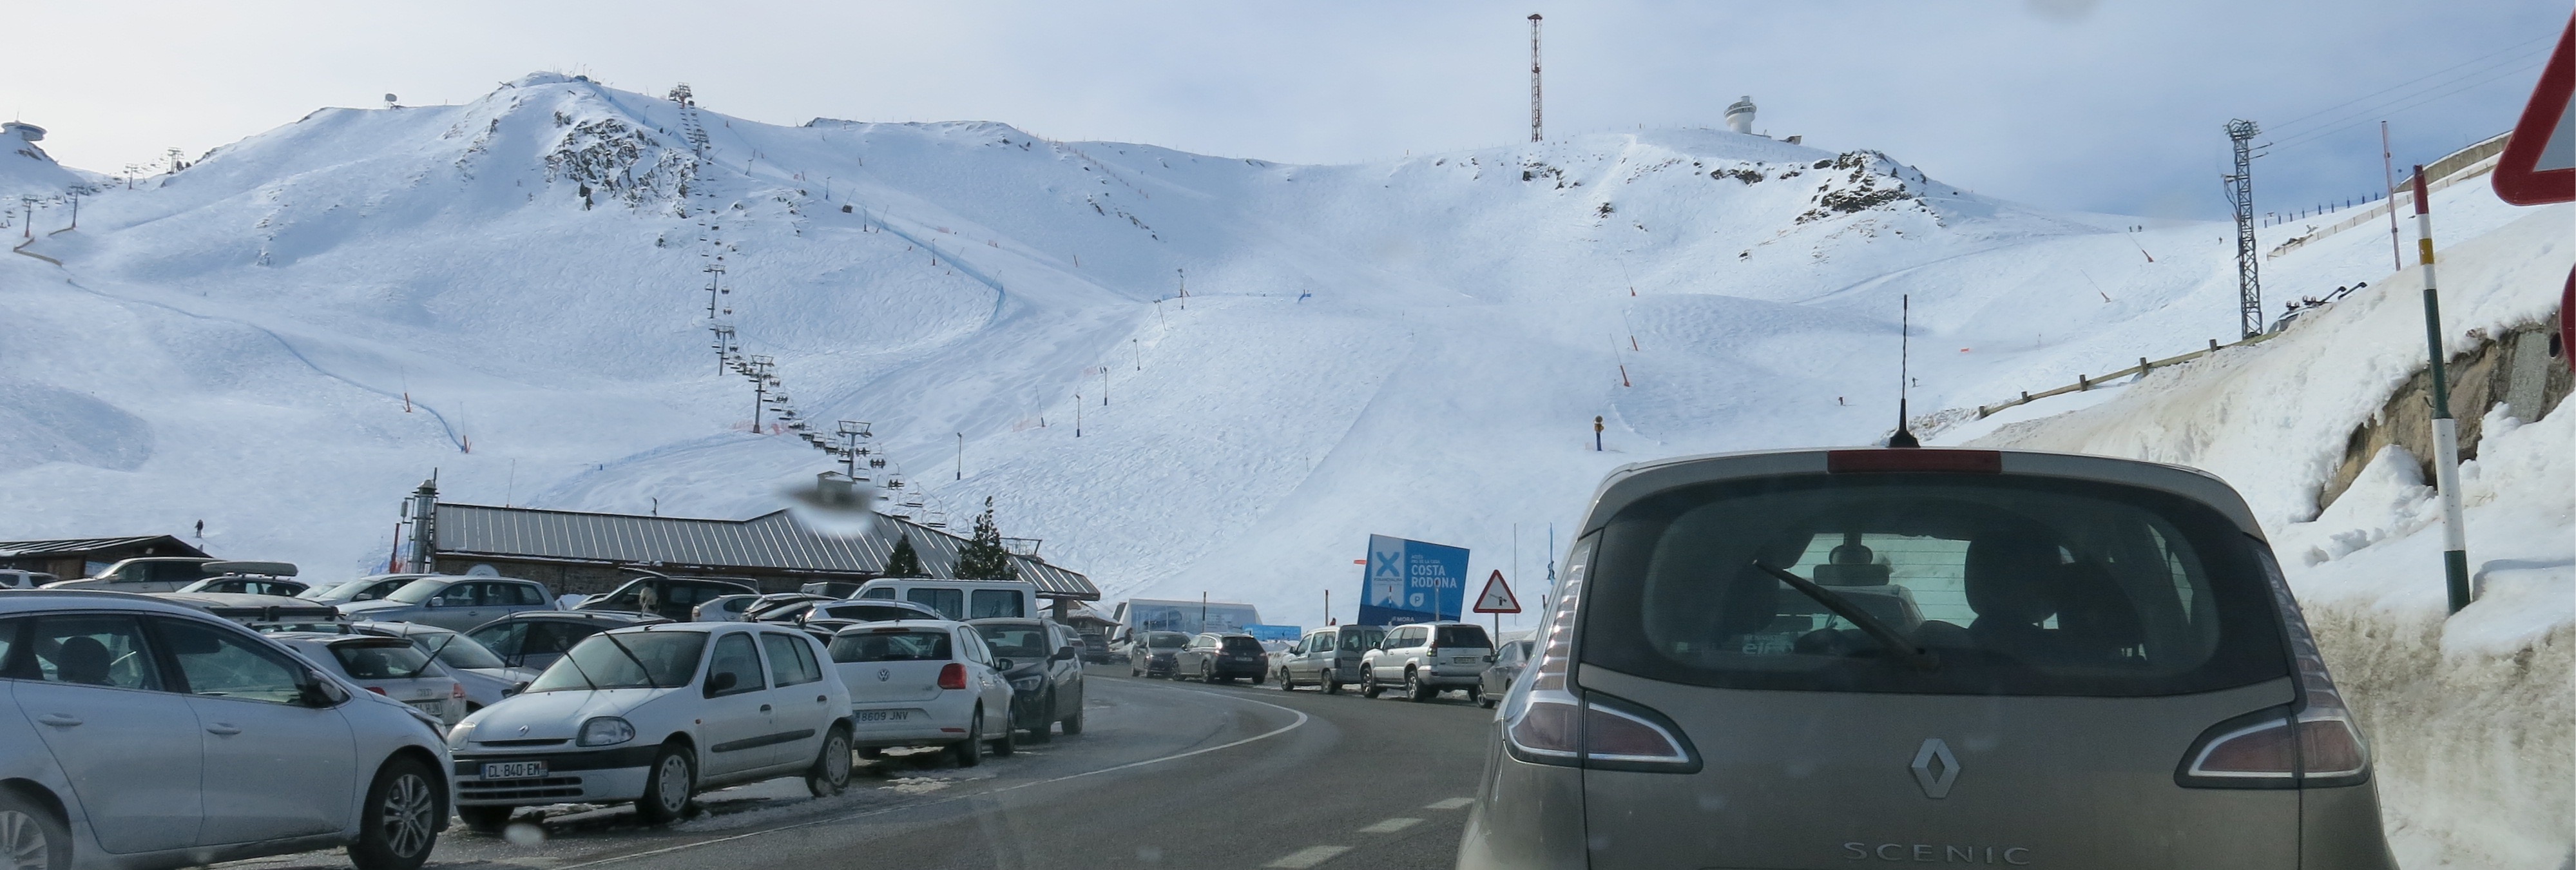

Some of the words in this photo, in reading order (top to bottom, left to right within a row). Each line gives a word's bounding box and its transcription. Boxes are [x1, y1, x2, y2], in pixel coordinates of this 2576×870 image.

[1411, 565, 1446, 575] COSTA
[1411, 577, 1457, 588] RODONA
[861, 712, 886, 721] 8609
[890, 711, 908, 720] JNV
[1843, 841, 2030, 865] SCENIC
